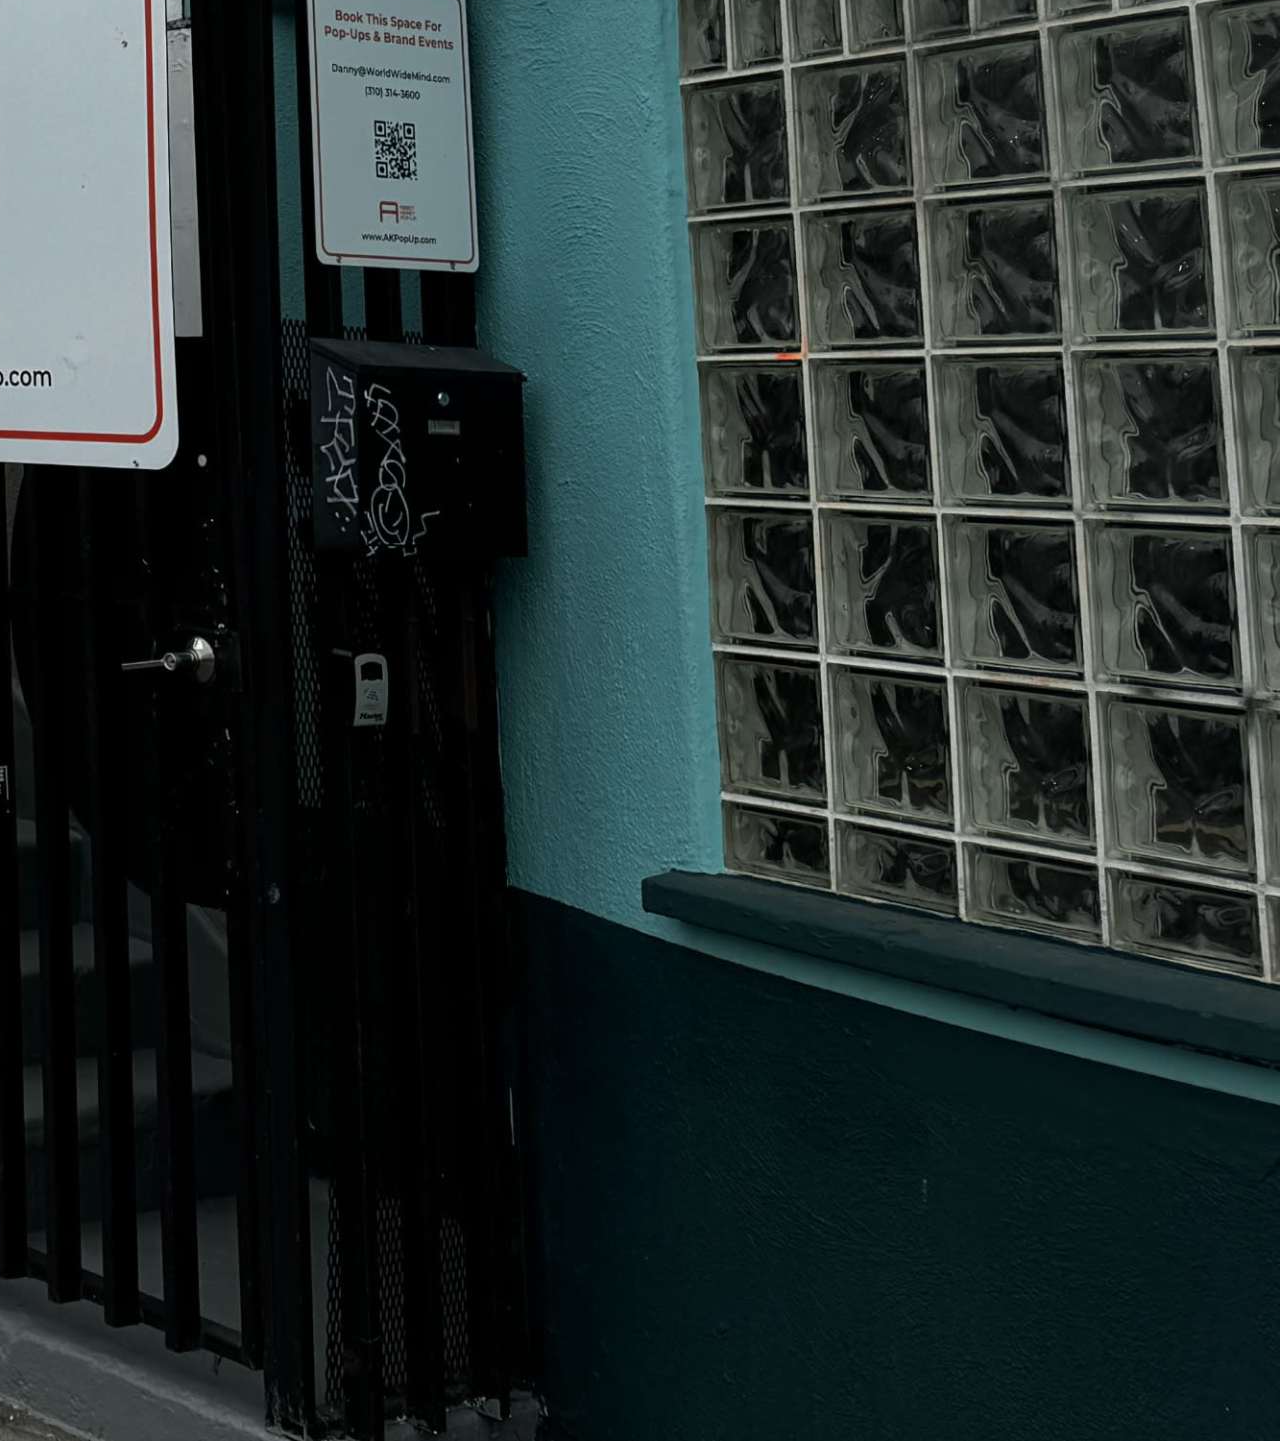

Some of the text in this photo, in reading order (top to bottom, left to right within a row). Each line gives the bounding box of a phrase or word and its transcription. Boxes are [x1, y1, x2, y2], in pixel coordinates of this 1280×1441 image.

[335, 9, 442, 32] Book This Space For
[324, 25, 455, 51] Pop-Ups & Brand Events
[331, 63, 451, 84] Danny@WorldWideMind.com
[365, 85, 421, 101] (310) 314-3600
[361, 232, 437, 246] www.AKPopUp.com
